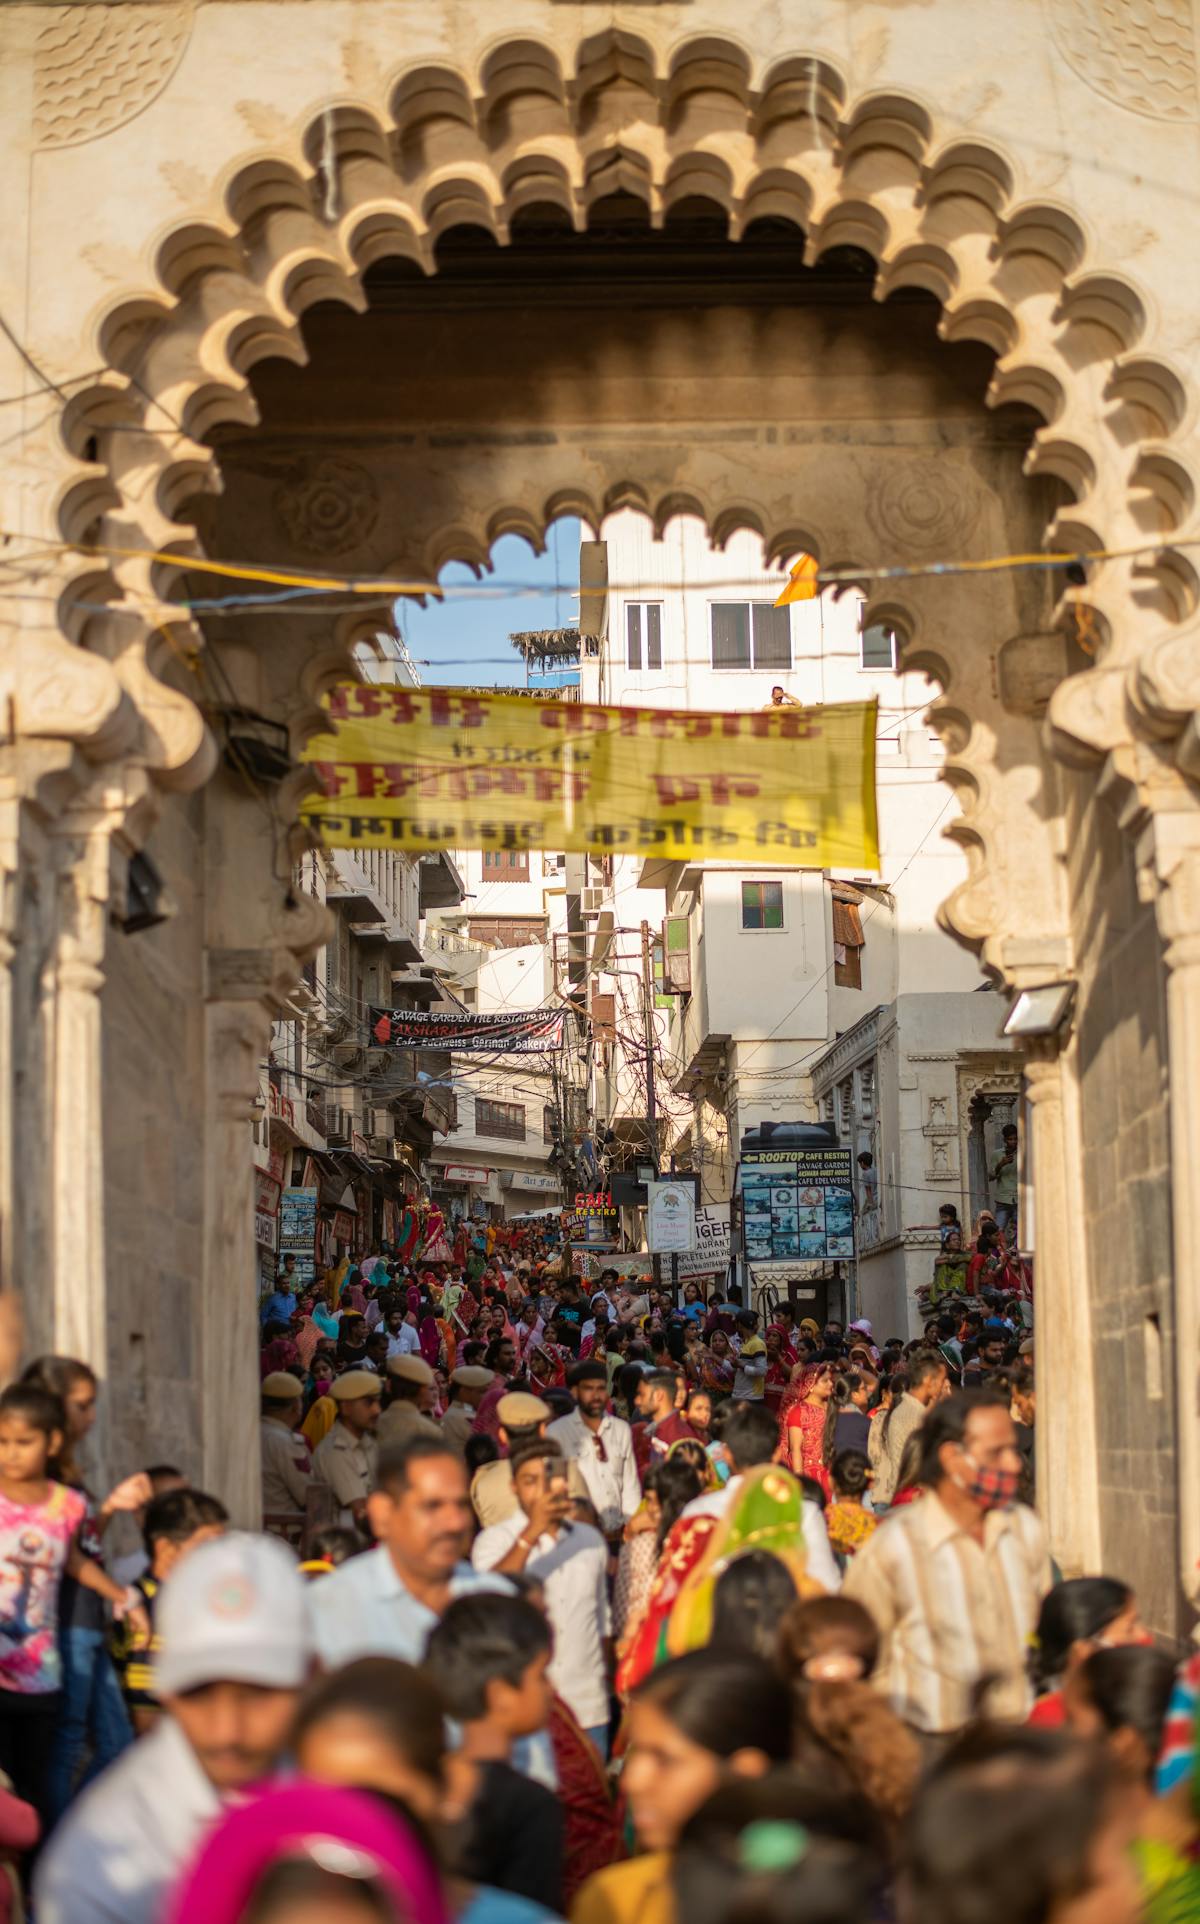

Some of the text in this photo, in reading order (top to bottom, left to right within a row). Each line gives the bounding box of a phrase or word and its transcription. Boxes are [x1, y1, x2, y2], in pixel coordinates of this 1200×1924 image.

[391, 1010, 430, 1022] SAVAGE
[430, 1013, 471, 1023] GARDEN
[473, 1014, 492, 1024] THE
[394, 1023, 458, 1036] AKSHARA
[758, 1152, 805, 1163] ROOFTOP
[805, 1152, 823, 1160] CAFE
[797, 1161, 850, 1170] SAVAGE GARDEN
[522, 1175, 536, 1185] Art
[798, 1176, 850, 1185] CAFE EDELWEISS
[575, 1207, 617, 1217] RESTRO
